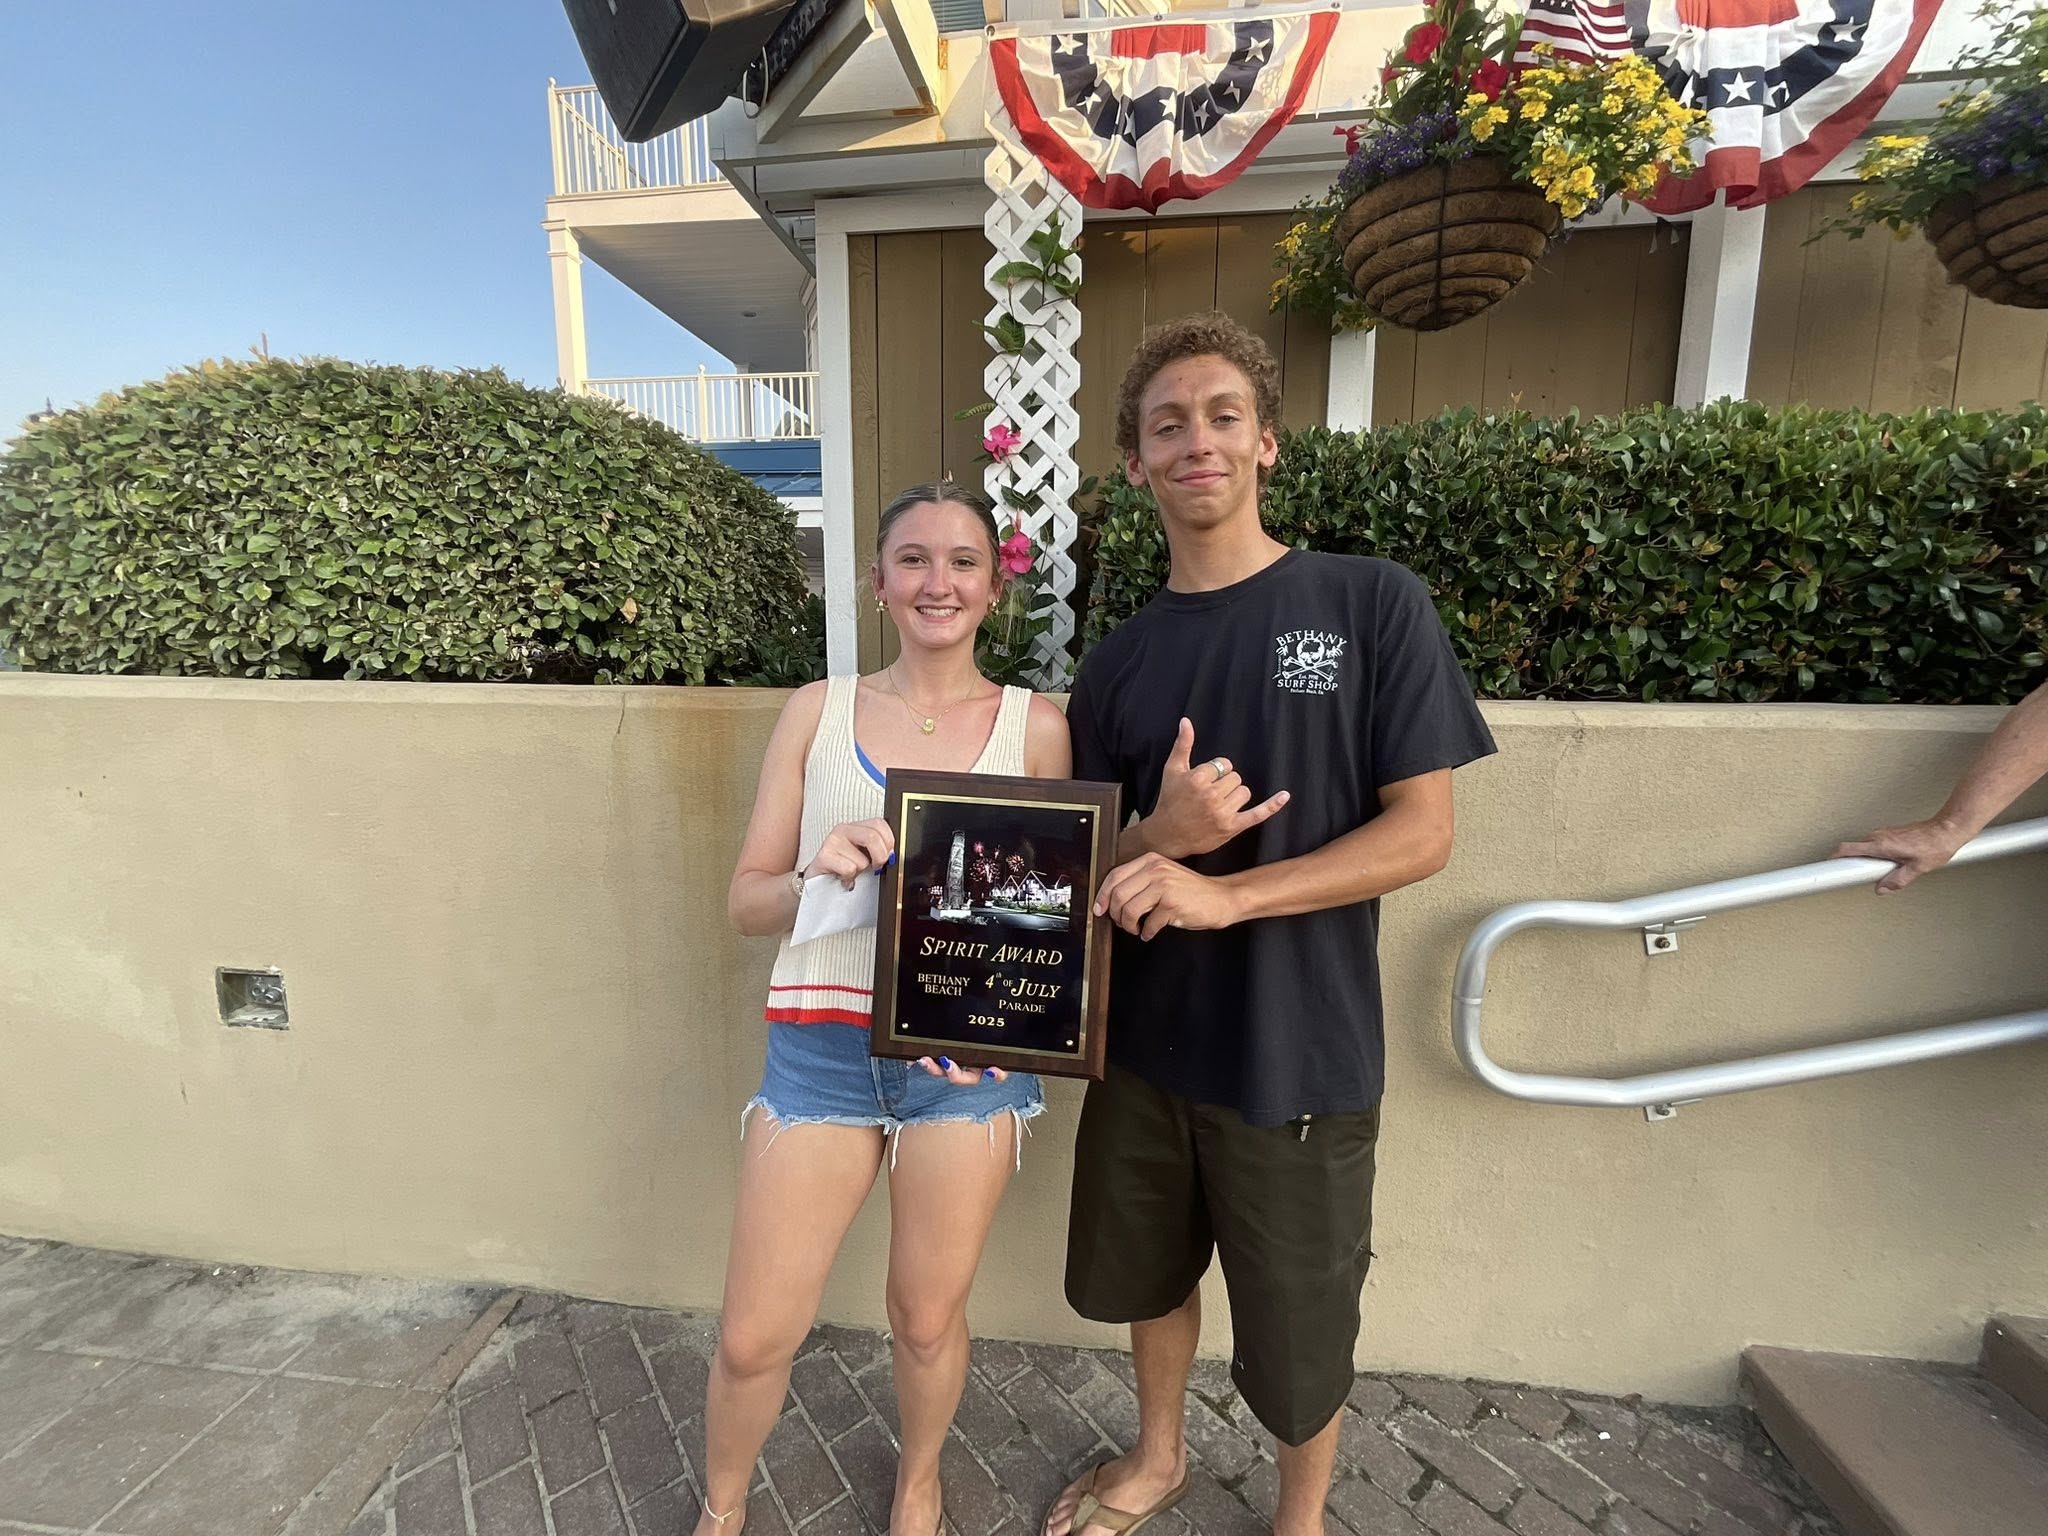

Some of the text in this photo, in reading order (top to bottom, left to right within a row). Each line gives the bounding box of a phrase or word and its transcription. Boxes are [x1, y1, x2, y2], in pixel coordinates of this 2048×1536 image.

[1275, 630, 1347, 649] BETHANY
[1277, 679, 1338, 691] SURF SHOP
[919, 936, 1063, 966] SPIRIT AWARD
[917, 973, 971, 987] BETHANY
[924, 983, 962, 996] BEACH
[1002, 979, 1014, 987] OF
[1010, 978, 1061, 998] JULY
[998, 999, 1046, 1013] PARADE
[968, 1014, 1005, 1027] 2025
